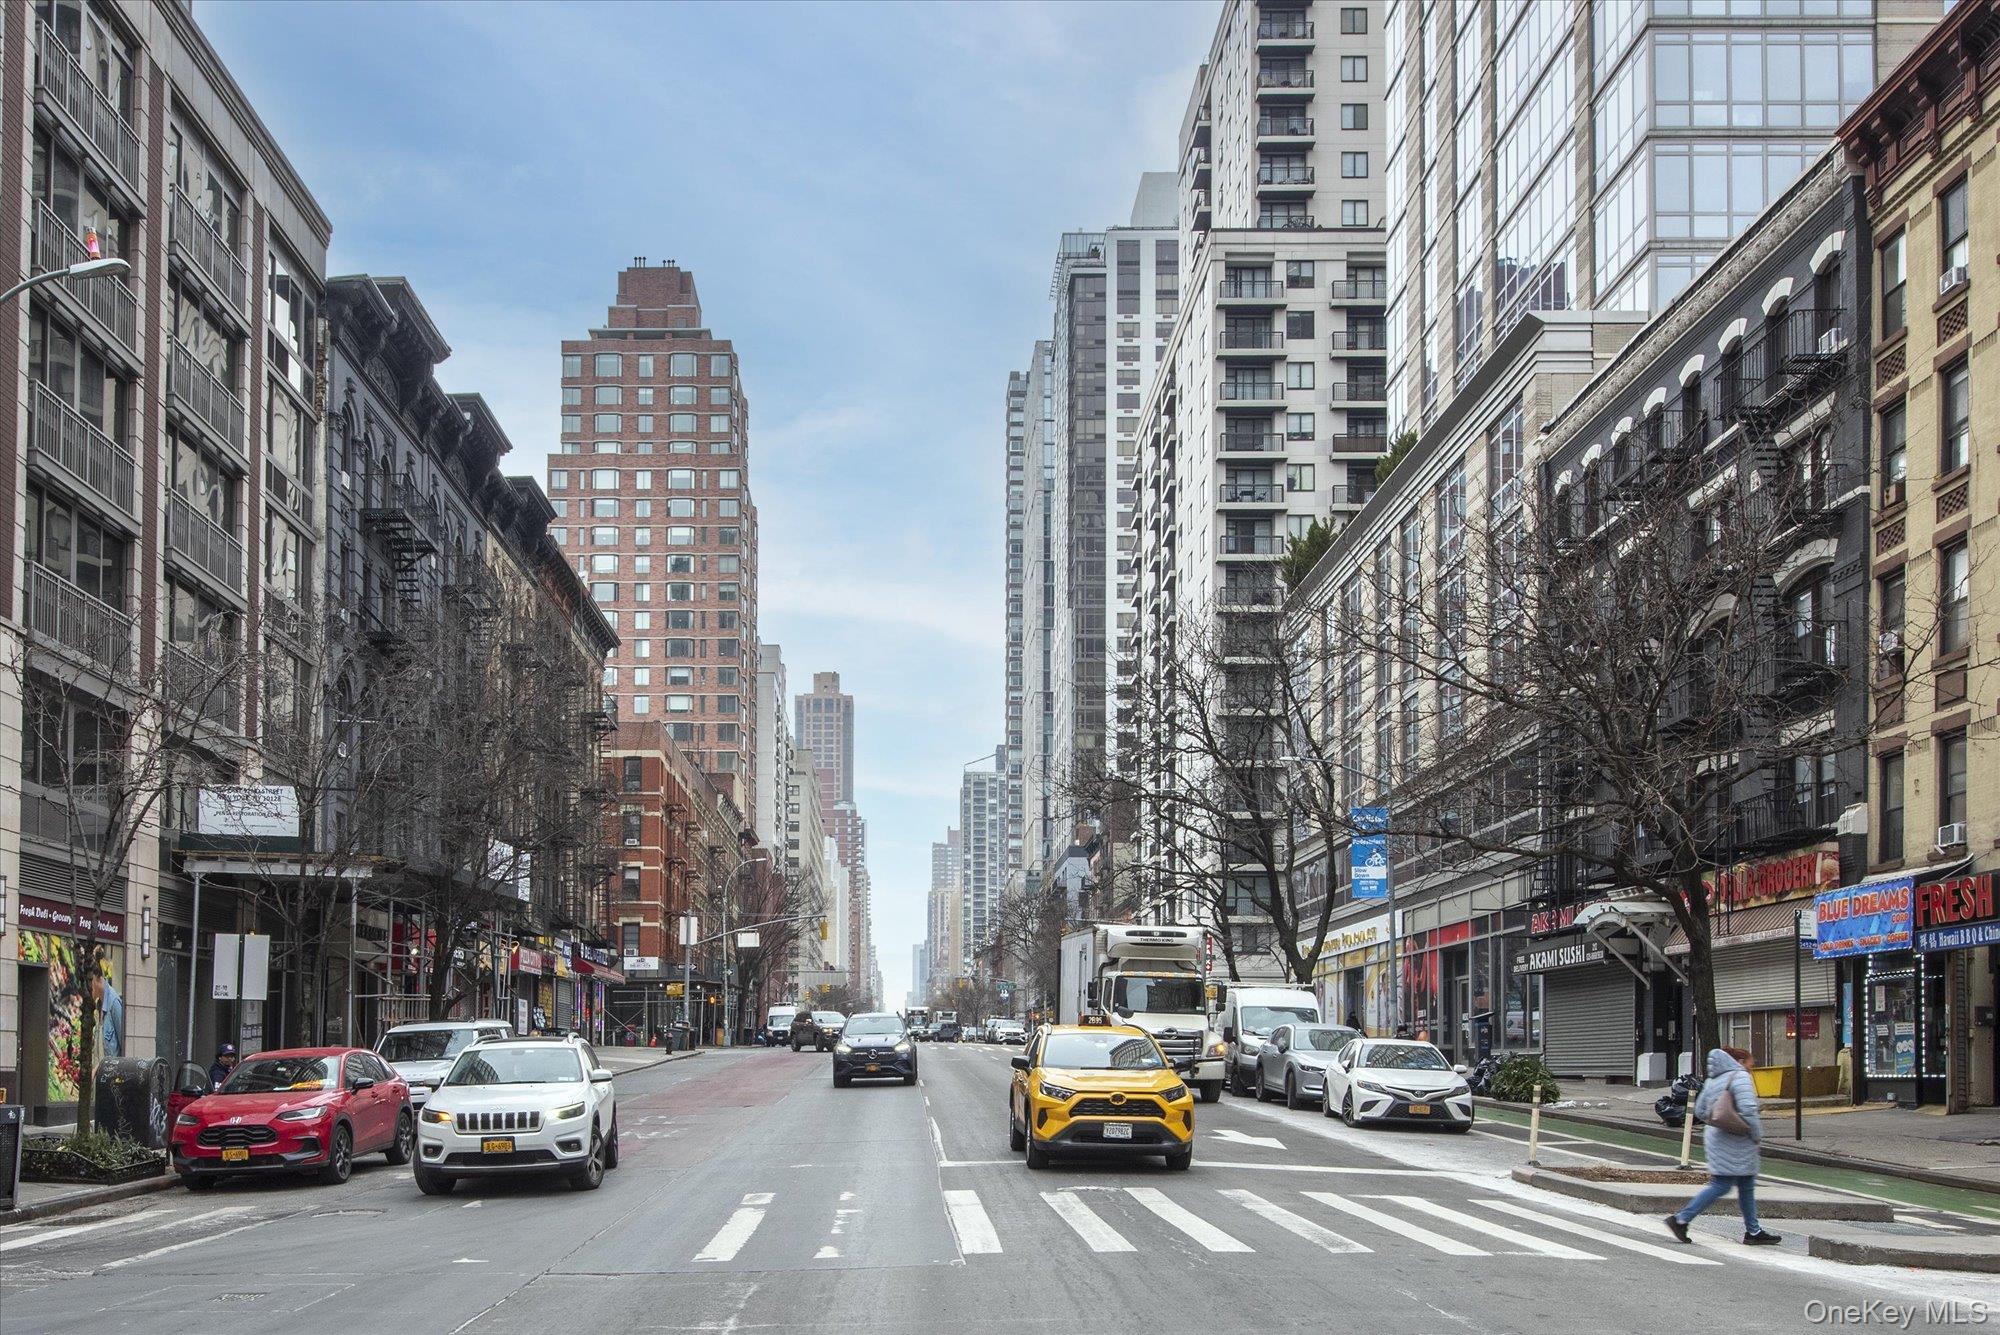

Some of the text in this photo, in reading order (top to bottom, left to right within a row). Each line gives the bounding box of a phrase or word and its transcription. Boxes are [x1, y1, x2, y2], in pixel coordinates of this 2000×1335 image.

[1758, 853, 1817, 896] GROCERY
[1818, 886, 1910, 923] BLUE DREAMS
[1916, 873, 1993, 927] FRESH
[79, 916, 93, 930] Fres
[1939, 931, 1959, 947] Hawaii
[1529, 949, 1558, 970] AKAMI
[1559, 944, 1585, 966] SUSHI
